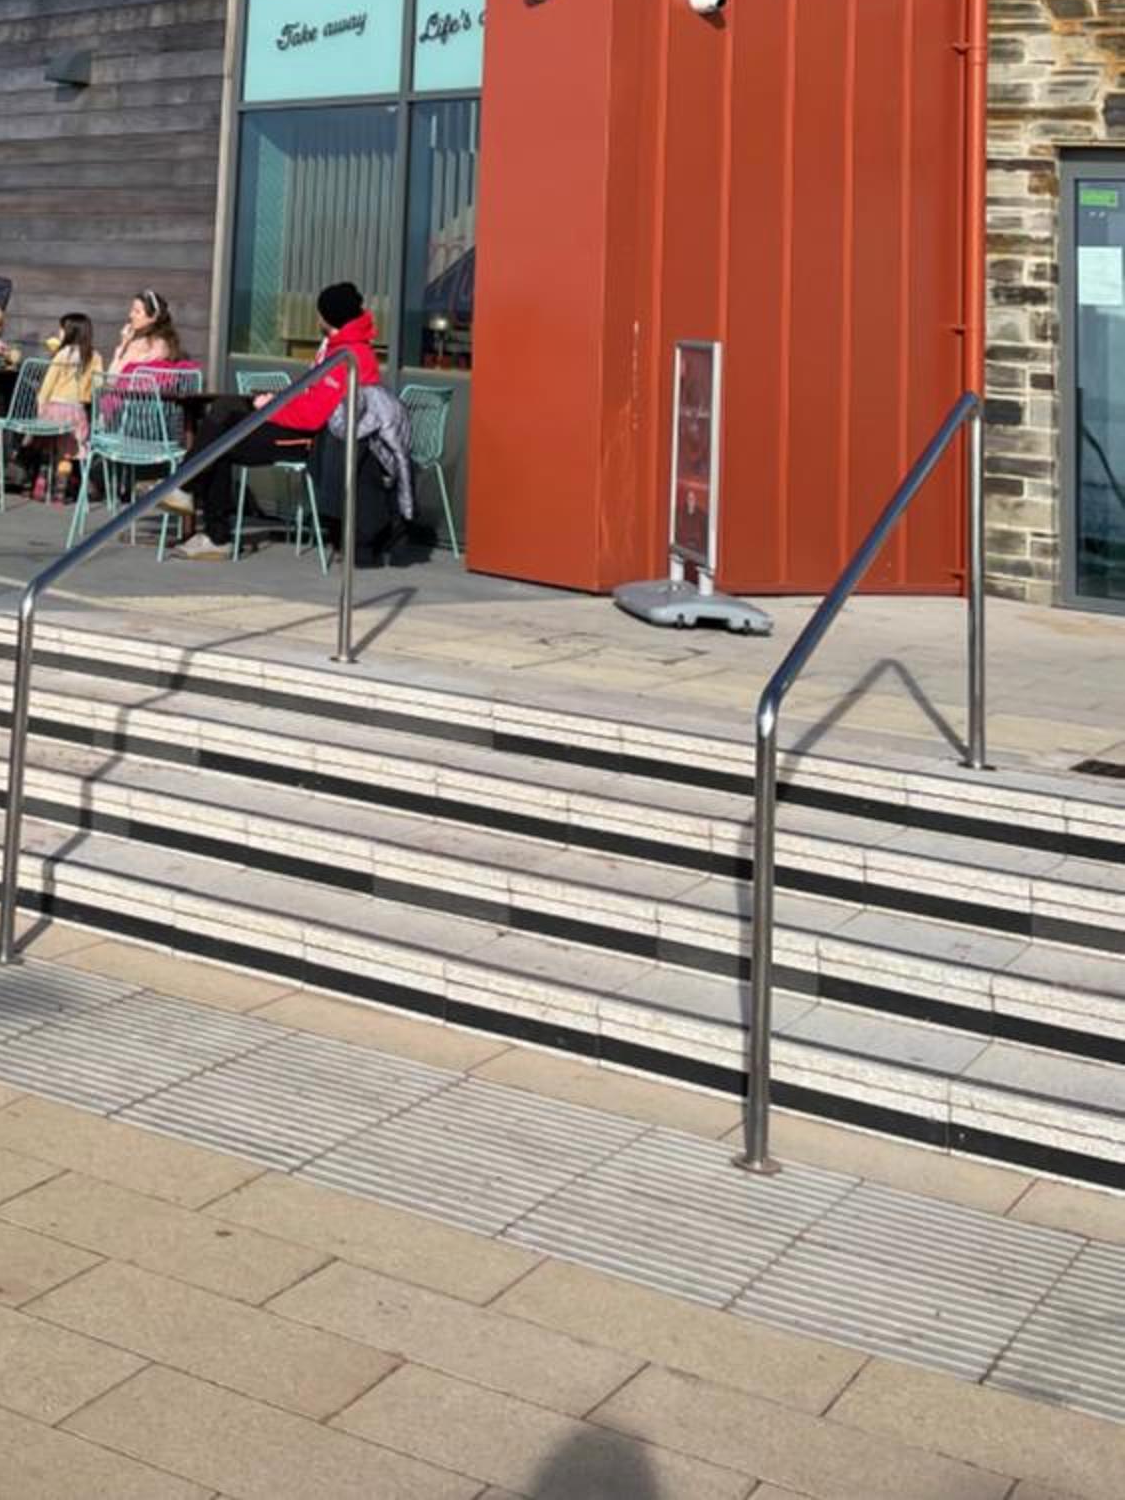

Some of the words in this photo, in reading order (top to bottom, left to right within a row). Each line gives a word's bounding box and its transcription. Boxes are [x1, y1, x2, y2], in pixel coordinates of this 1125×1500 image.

[276, 21, 318, 51] Take
[322, 11, 368, 37] away
[419, 9, 472, 45] Life's
